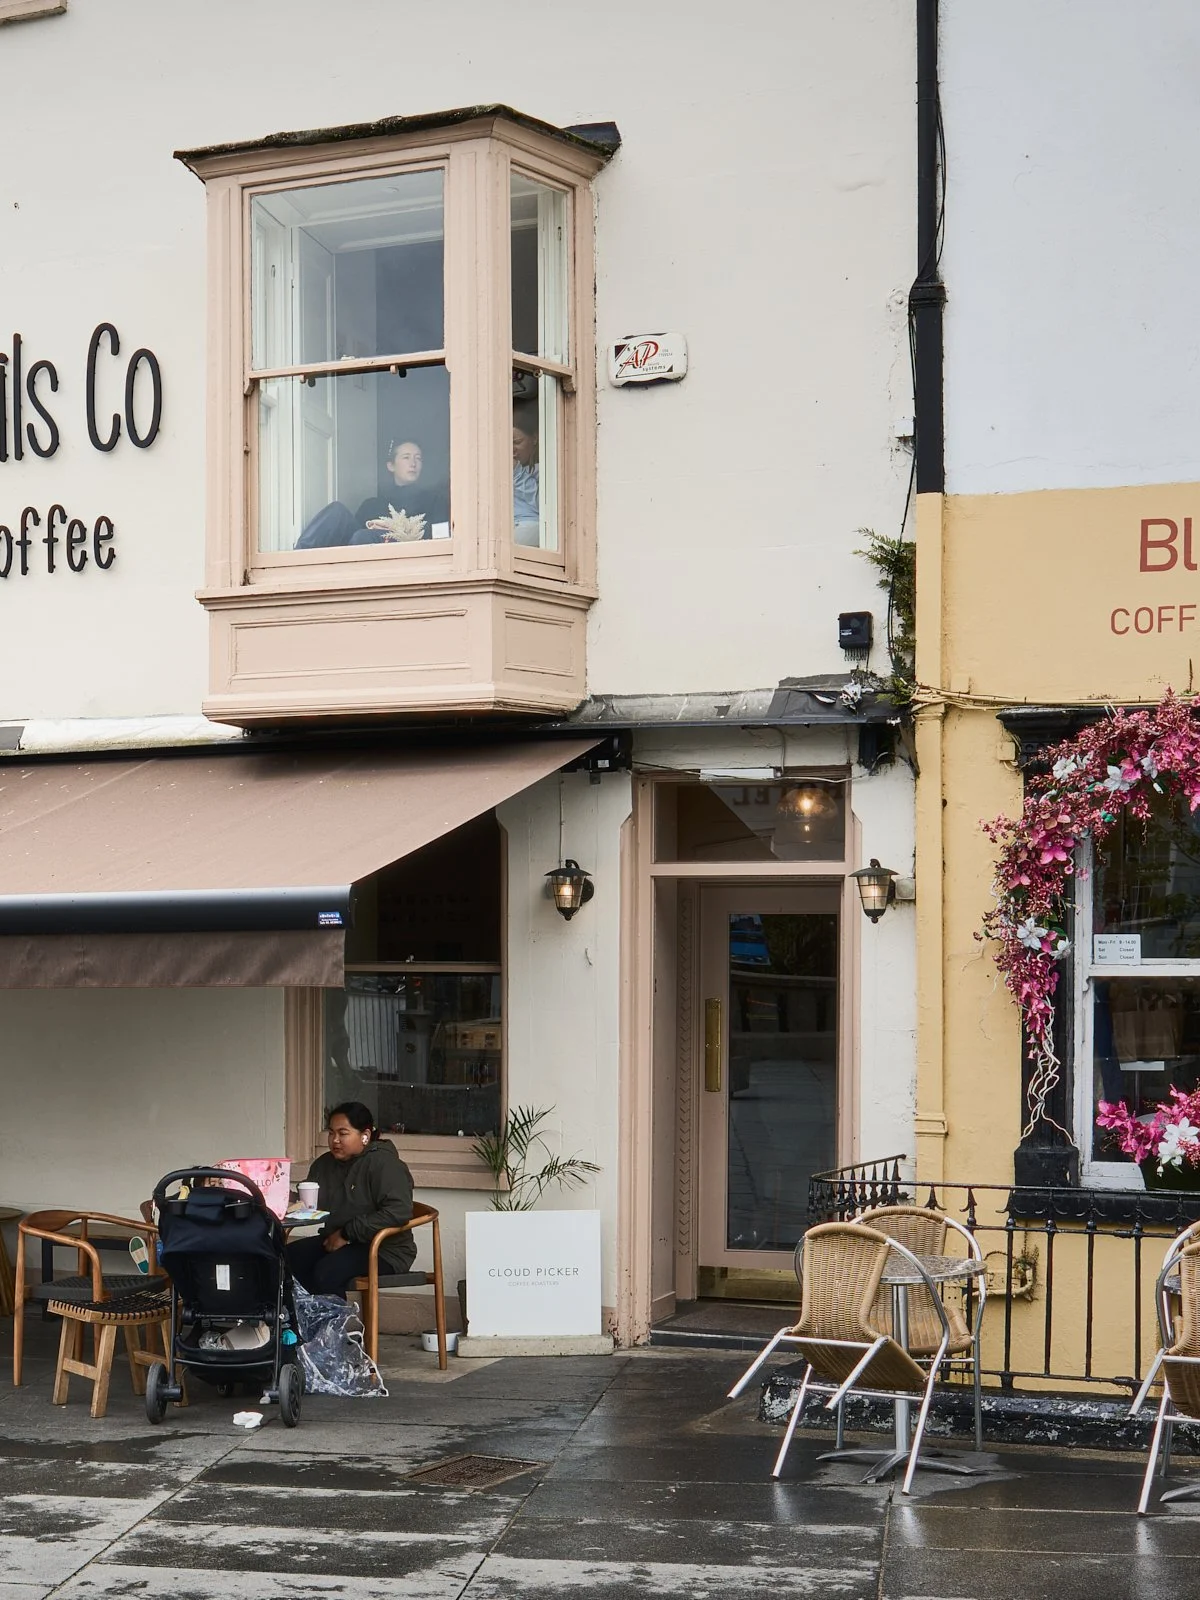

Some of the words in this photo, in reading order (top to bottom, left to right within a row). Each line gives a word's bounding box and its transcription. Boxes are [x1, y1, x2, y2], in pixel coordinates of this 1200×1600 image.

[86, 322, 162, 453] Co
[1110, 604, 1197, 635] COFF
[488, 1268, 530, 1277] CLOUD
[536, 1267, 579, 1276] PICKER
